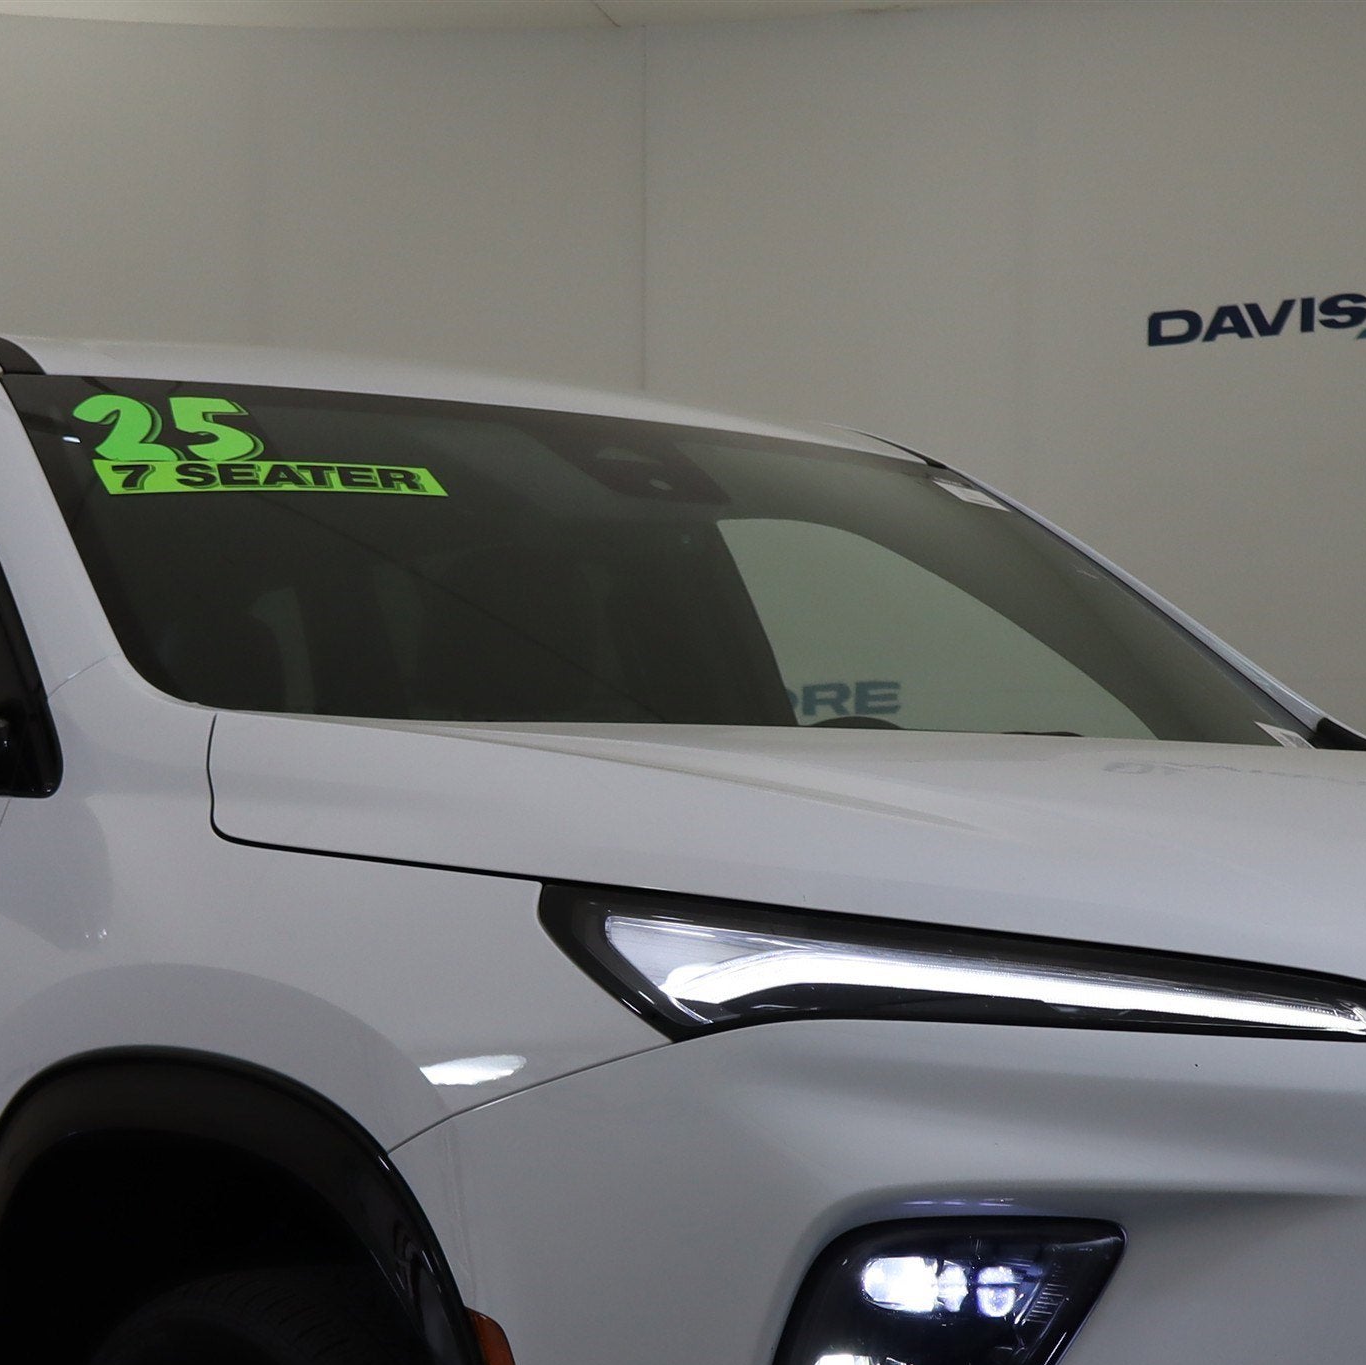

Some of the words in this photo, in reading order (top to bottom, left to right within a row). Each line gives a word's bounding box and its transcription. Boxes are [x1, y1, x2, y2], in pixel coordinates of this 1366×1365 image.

[73, 394, 264, 461] 25
[111, 464, 155, 489] 7
[175, 464, 426, 493] SEATER
